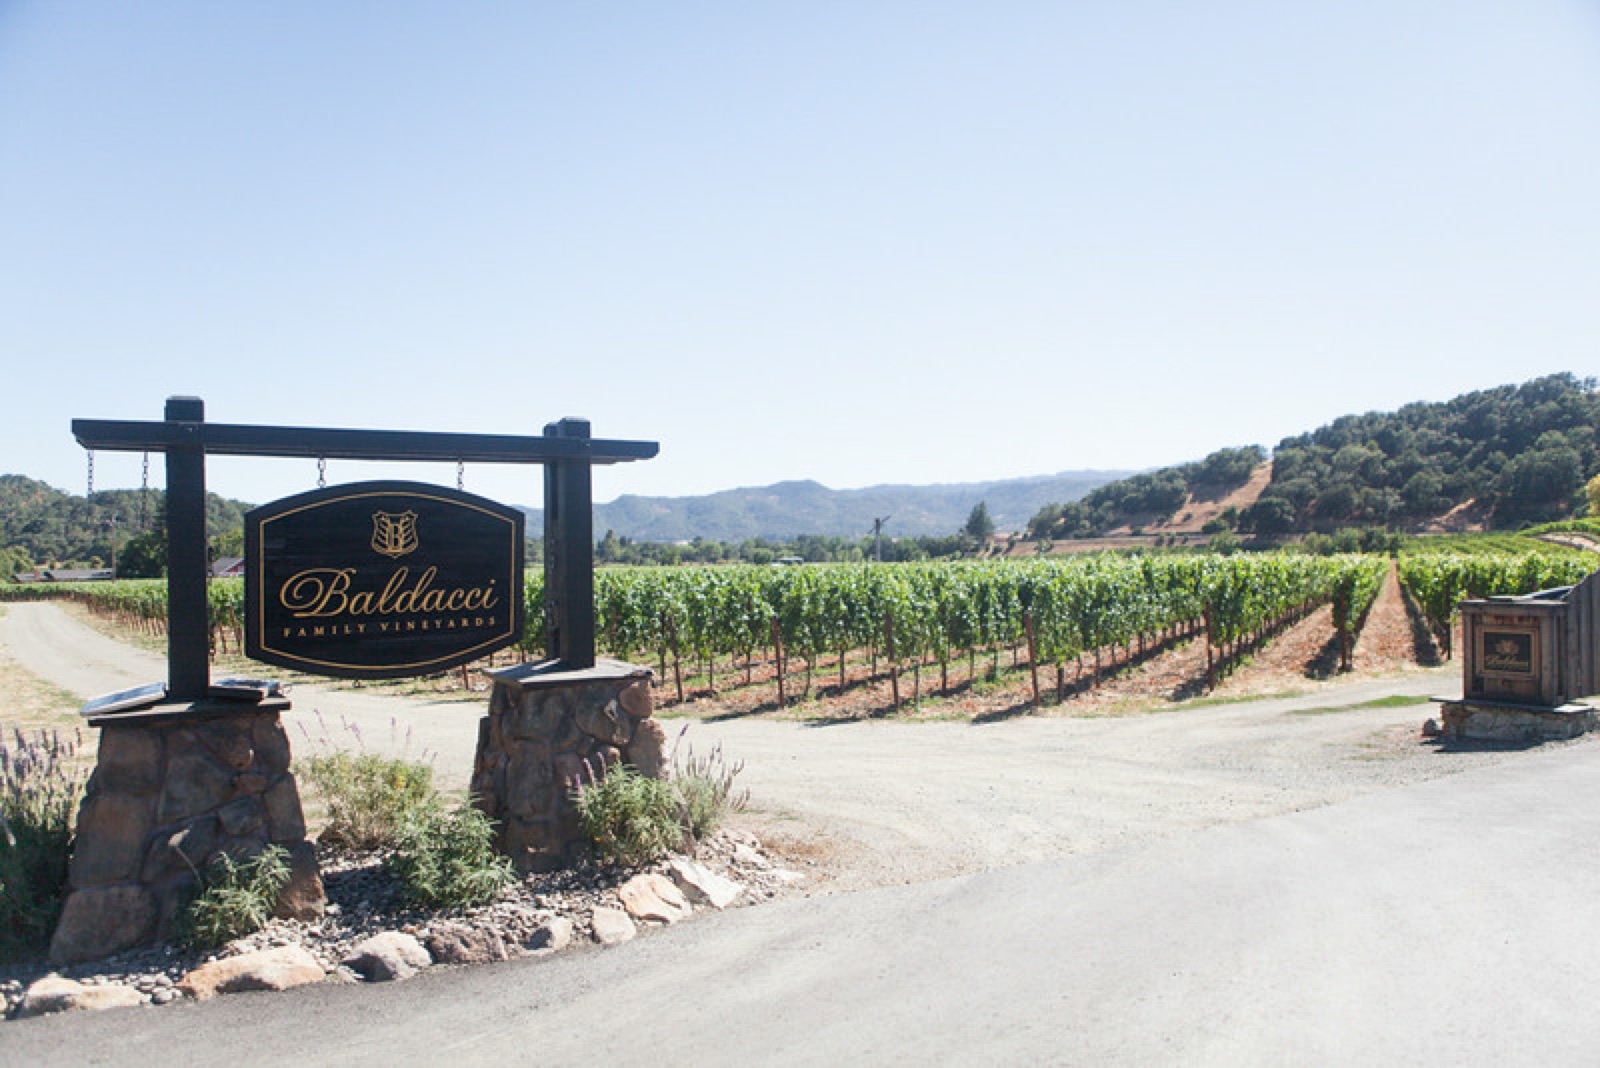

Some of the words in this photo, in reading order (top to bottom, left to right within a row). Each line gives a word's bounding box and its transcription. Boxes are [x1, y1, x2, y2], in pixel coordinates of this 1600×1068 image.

[279, 565, 499, 617] Baldacci
[283, 623, 367, 638] FAMILY
[379, 616, 496, 631] VINEYARDS
